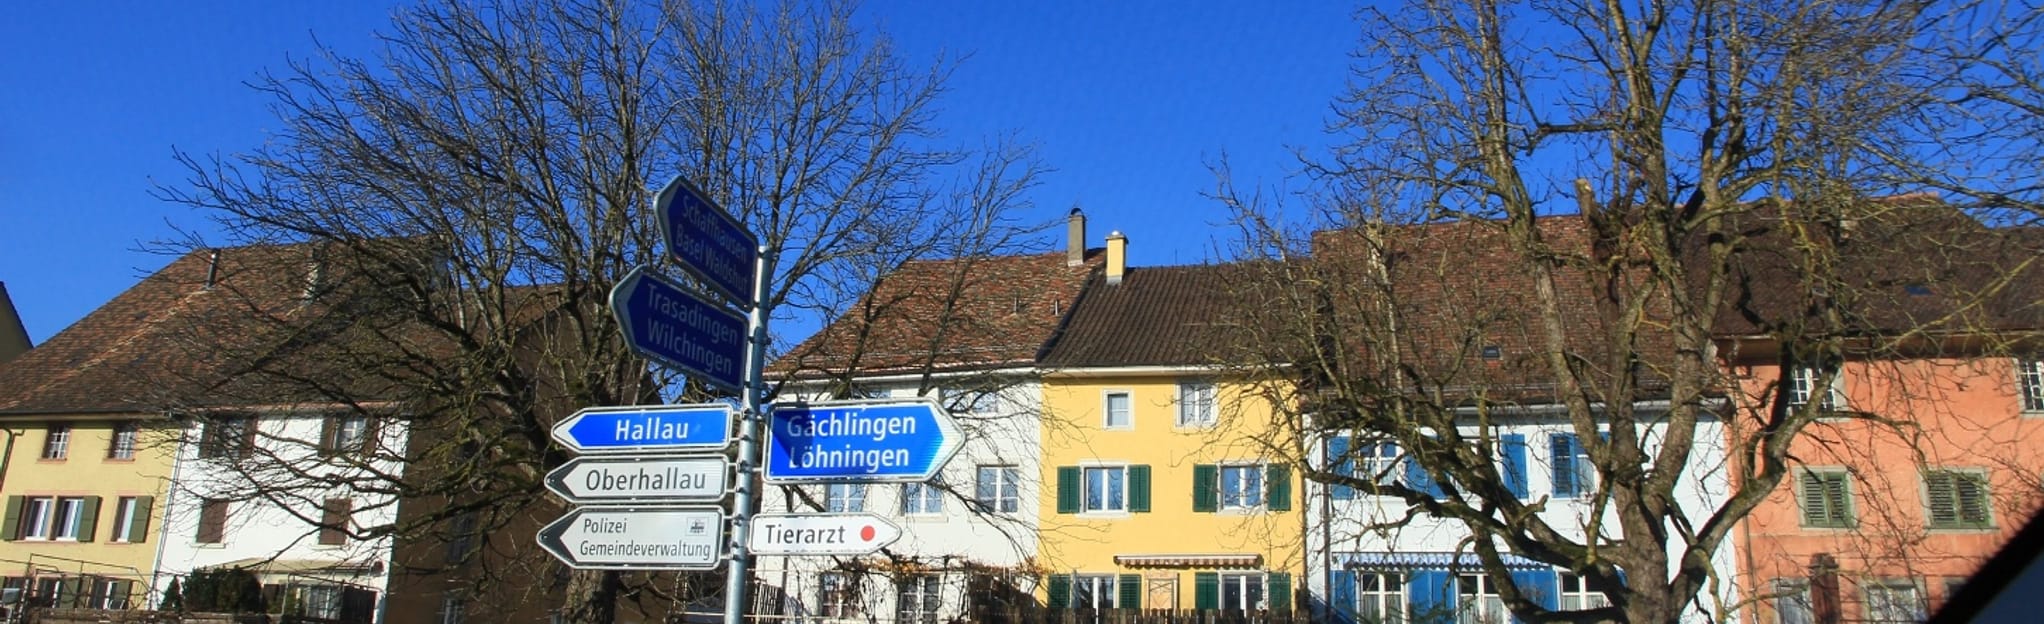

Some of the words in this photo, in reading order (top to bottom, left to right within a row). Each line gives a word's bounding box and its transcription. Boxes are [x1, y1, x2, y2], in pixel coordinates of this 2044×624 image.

[682, 195, 747, 263] Schaffhausen
[677, 223, 699, 260] Basel
[704, 245, 748, 296] Waldshut
[648, 282, 738, 346] Trasadingen
[648, 317, 732, 376] Wilchingen
[615, 417, 688, 441] Hallau
[787, 412, 916, 441] Gächlingen
[789, 444, 909, 473] Löhningen
[586, 467, 706, 491] Oberhallau
[583, 518, 627, 534] Polizei
[765, 524, 845, 544] Tierarzt
[580, 540, 711, 561] Gemeindeverwaltung
